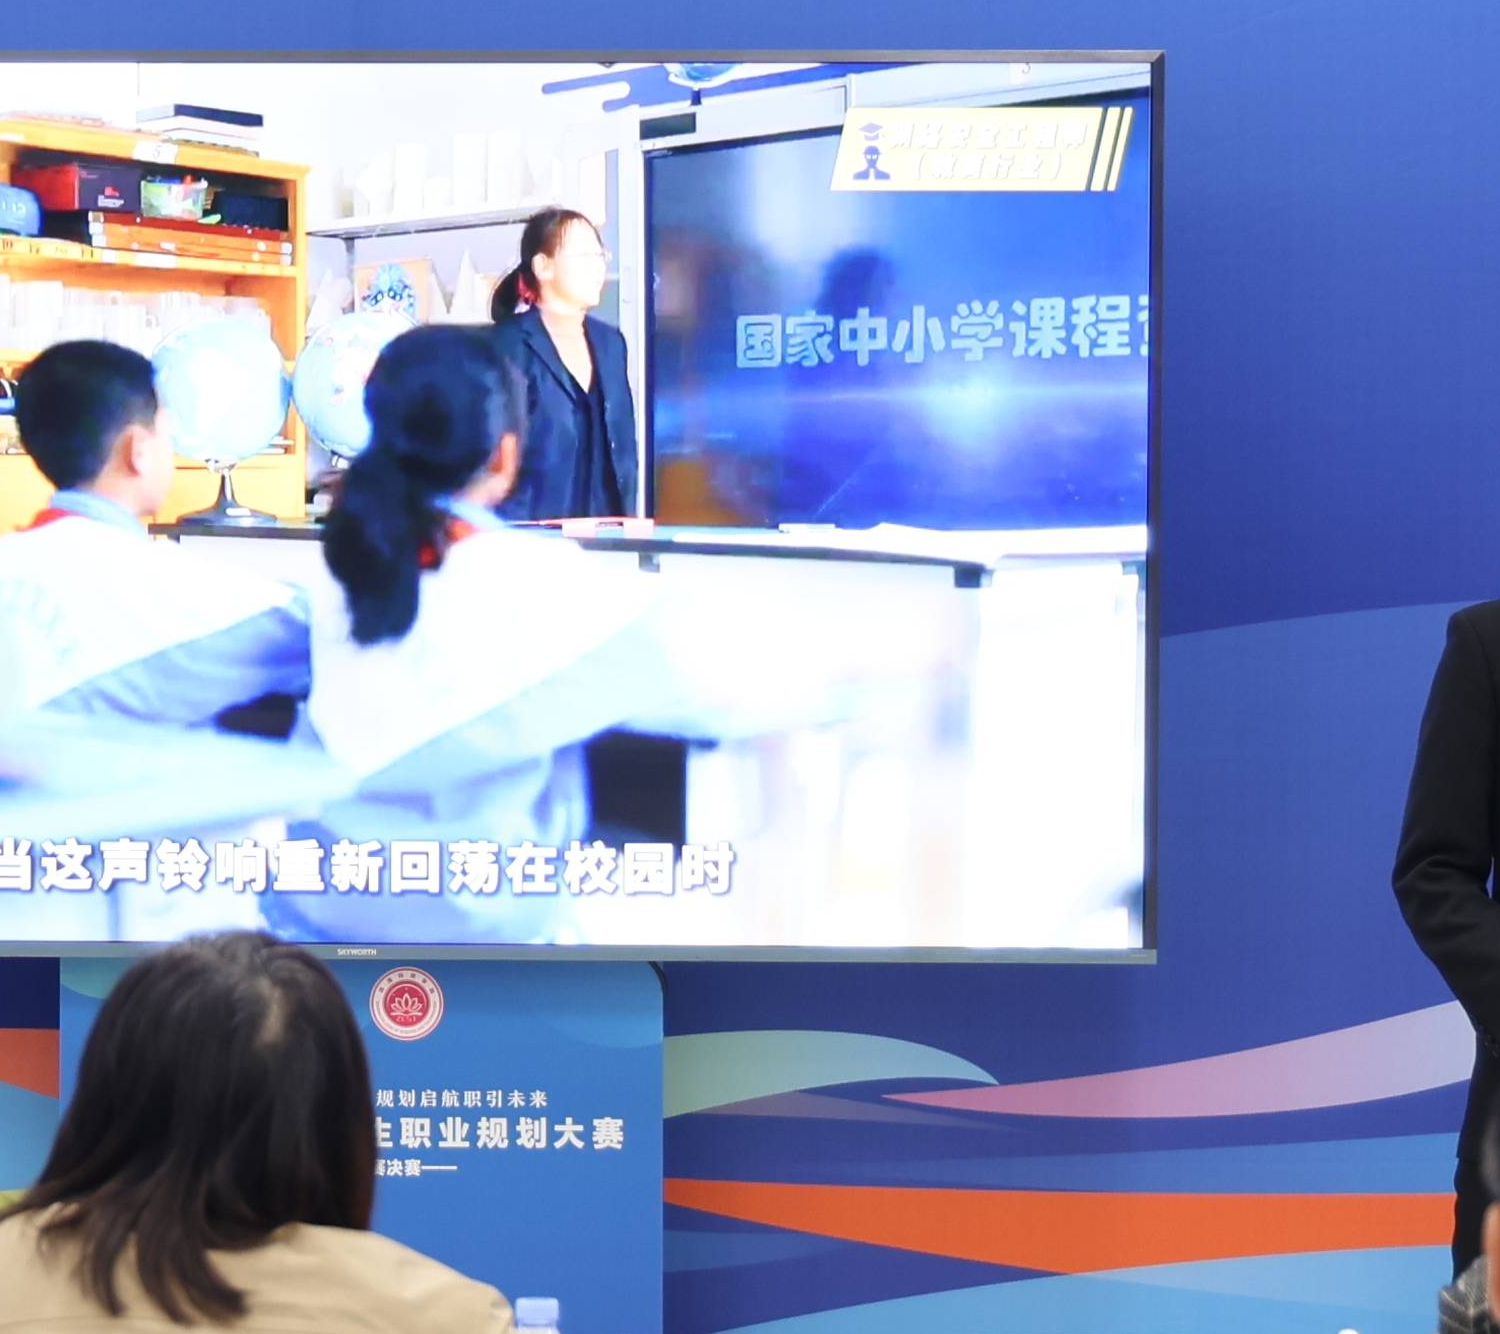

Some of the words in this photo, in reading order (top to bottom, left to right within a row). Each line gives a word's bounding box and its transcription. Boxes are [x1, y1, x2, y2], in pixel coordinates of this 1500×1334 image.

[735, 294, 1149, 369] 国家中小学课程
[336, 948, 377, 957] SKYWORTH
[376, 1089, 549, 1109] 规划启航职引未来
